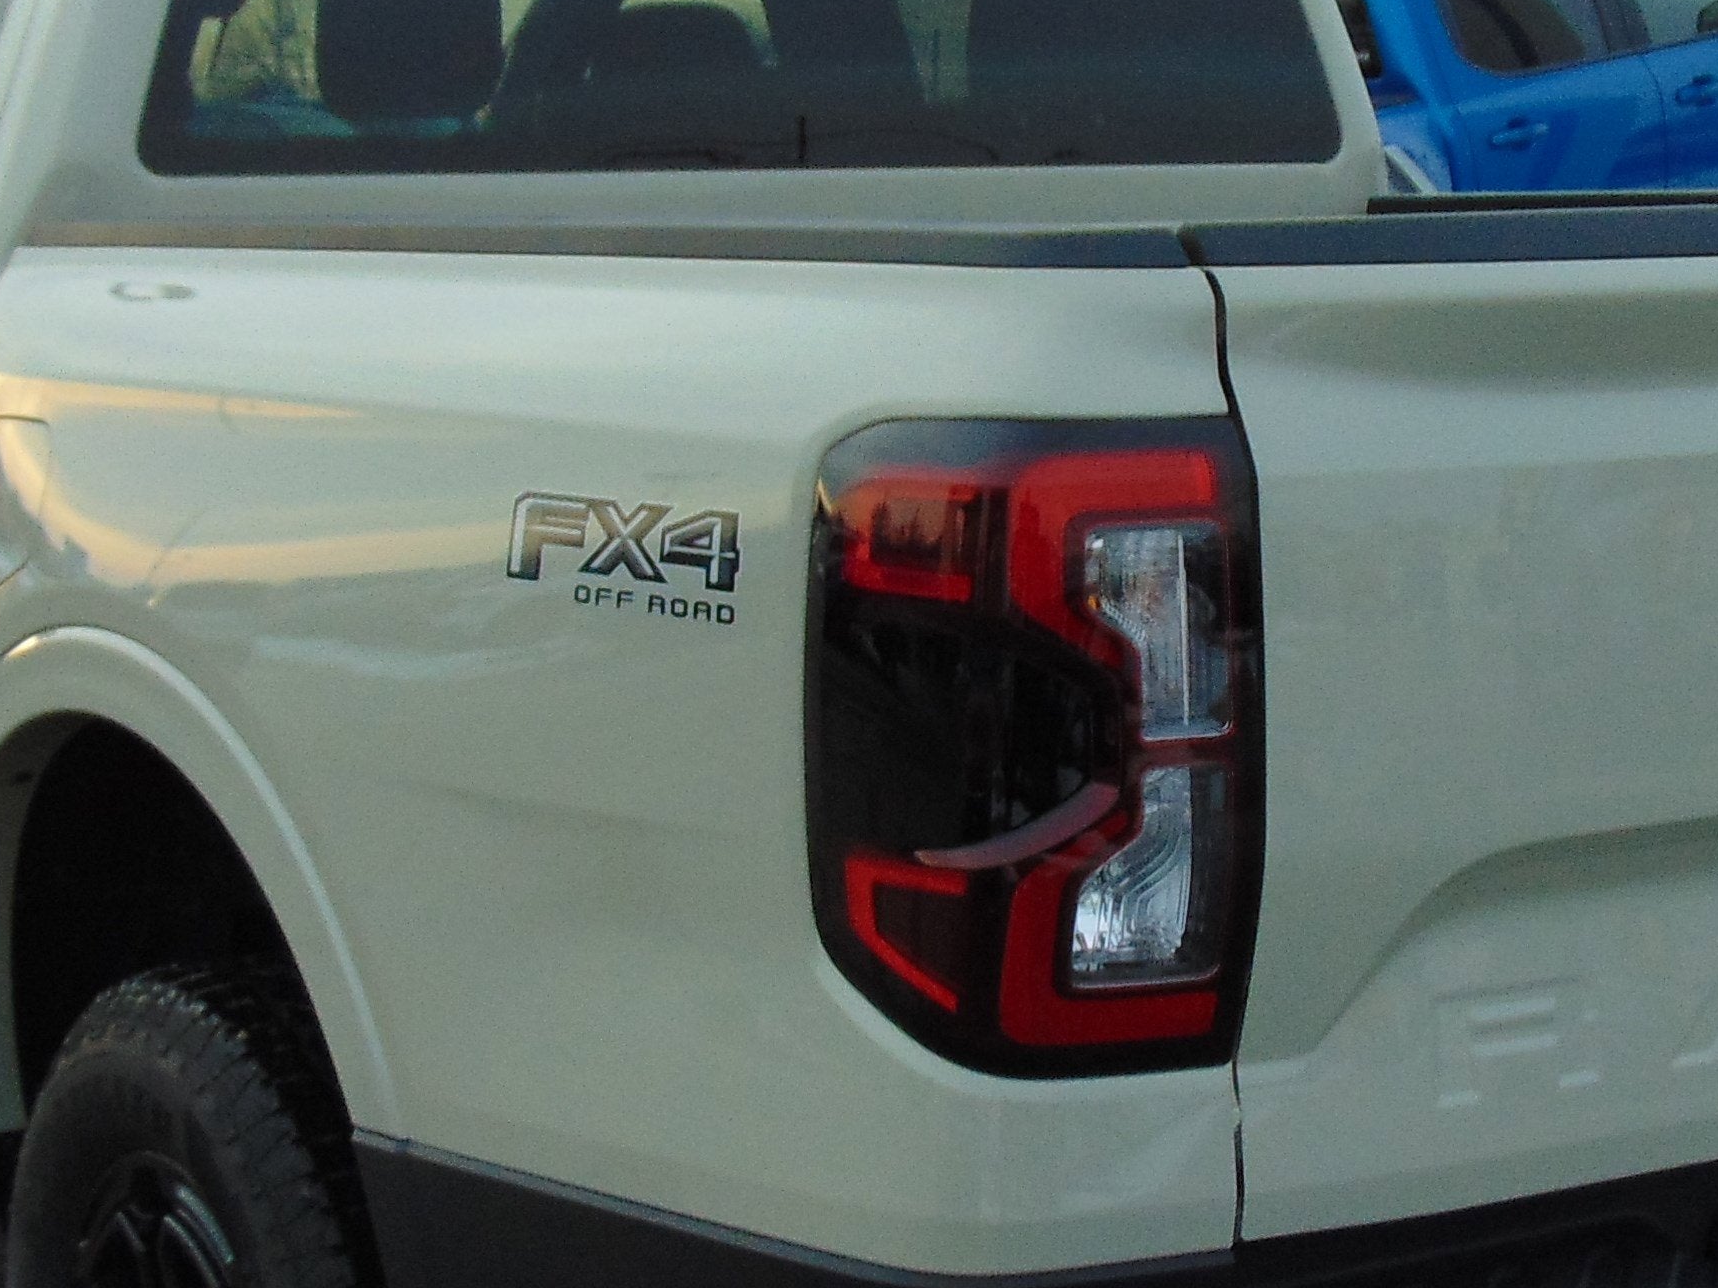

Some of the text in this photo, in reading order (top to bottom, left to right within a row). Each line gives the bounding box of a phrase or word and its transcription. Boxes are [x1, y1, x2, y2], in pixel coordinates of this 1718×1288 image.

[506, 489, 741, 594] FX4
[573, 584, 736, 625] OFF ROAD
